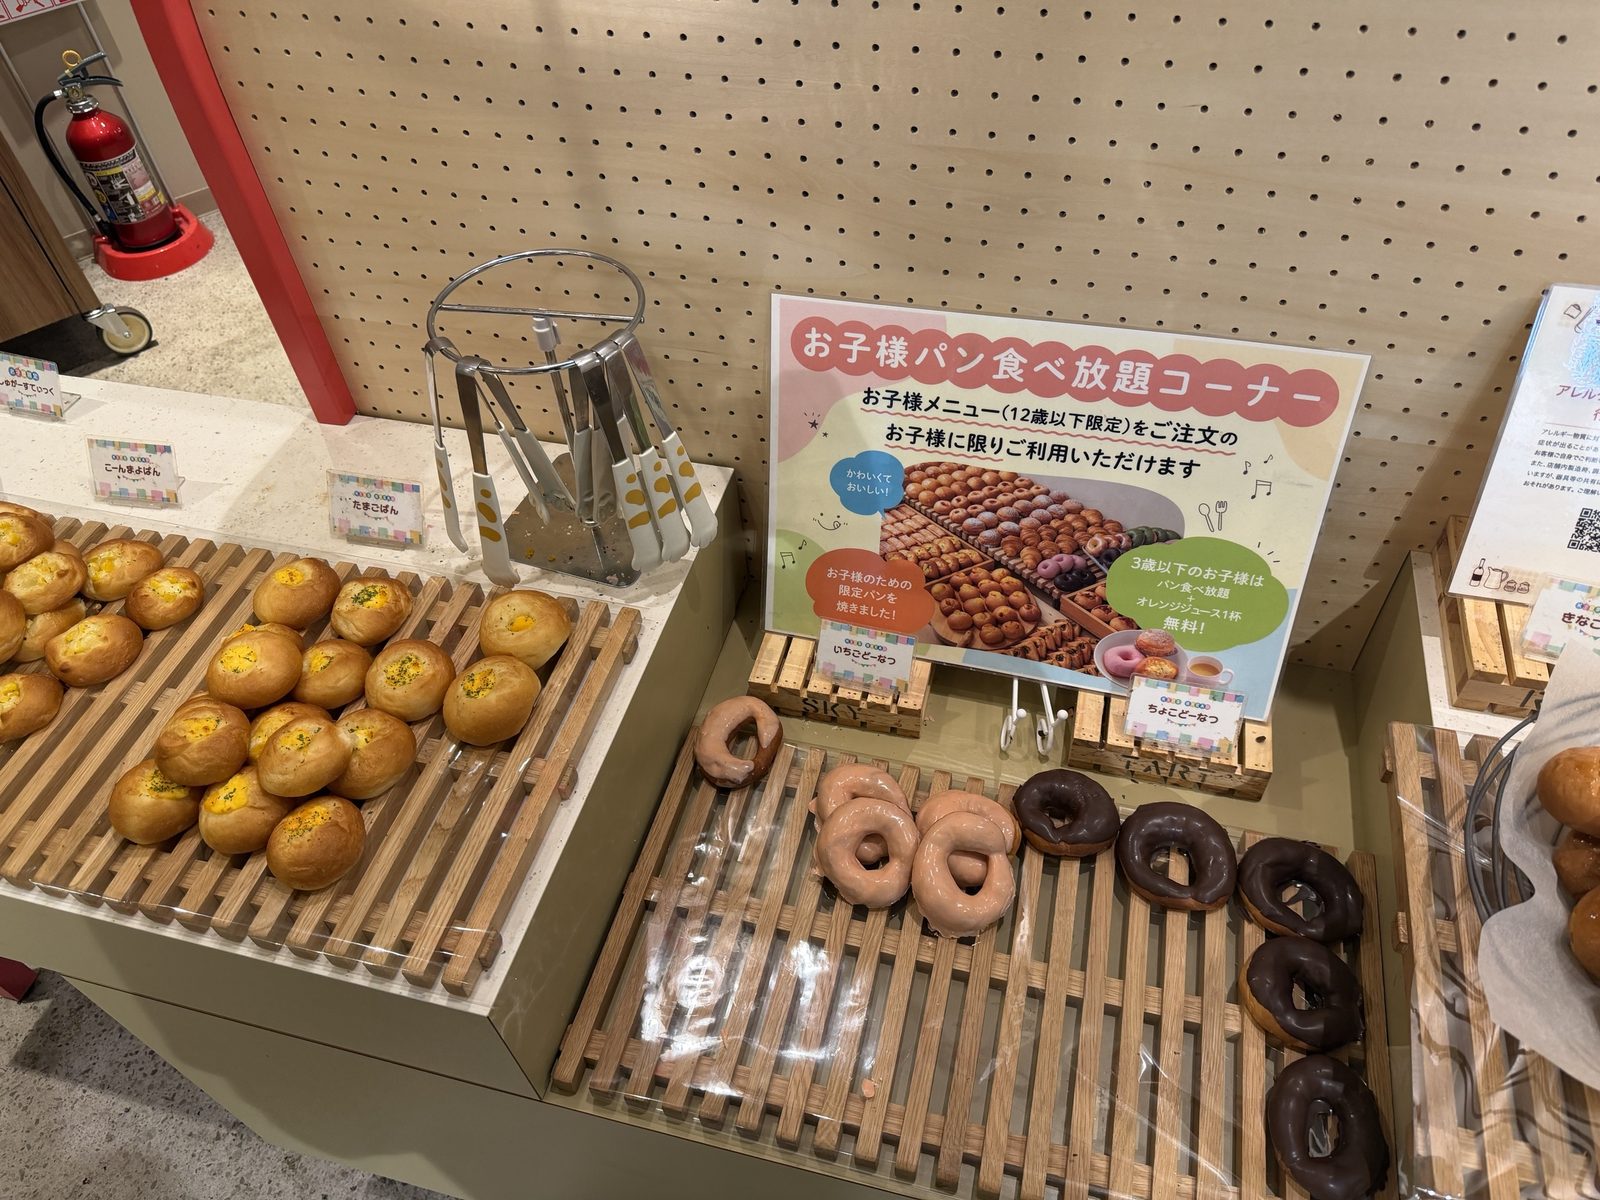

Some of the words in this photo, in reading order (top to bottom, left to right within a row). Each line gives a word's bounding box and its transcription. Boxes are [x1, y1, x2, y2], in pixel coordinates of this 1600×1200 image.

[803, 326, 1321, 407] お子様パン食べ放題コーナー
[861, 386, 1238, 447] お子様メニュー(12歳以下限定)をご注文の
[885, 422, 1201, 479] お子様に限りご利用いただけます
[104, 463, 160, 477] こーんまよぱん
[846, 468, 893, 484] かわいくて
[1530, 460, 1600, 475] また、店舗内製造時、調
[846, 481, 890, 497] おいしい!
[352, 500, 399, 515] たまごぱん
[826, 567, 912, 590] お子様のための
[1130, 556, 1265, 587] 3歳以下のお子様は
[838, 584, 898, 604] 限定パンを
[1156, 579, 1231, 599] パン食べ放題
[836, 600, 897, 620] 焼きました!
[1136, 596, 1243, 623] オレンジジュース1杯
[1163, 615, 1205, 635] 無料!
[833, 645, 896, 665] いちごどーなつ
[801, 697, 859, 720] SKY
[1148, 703, 1219, 724] ちょこどーなつ
